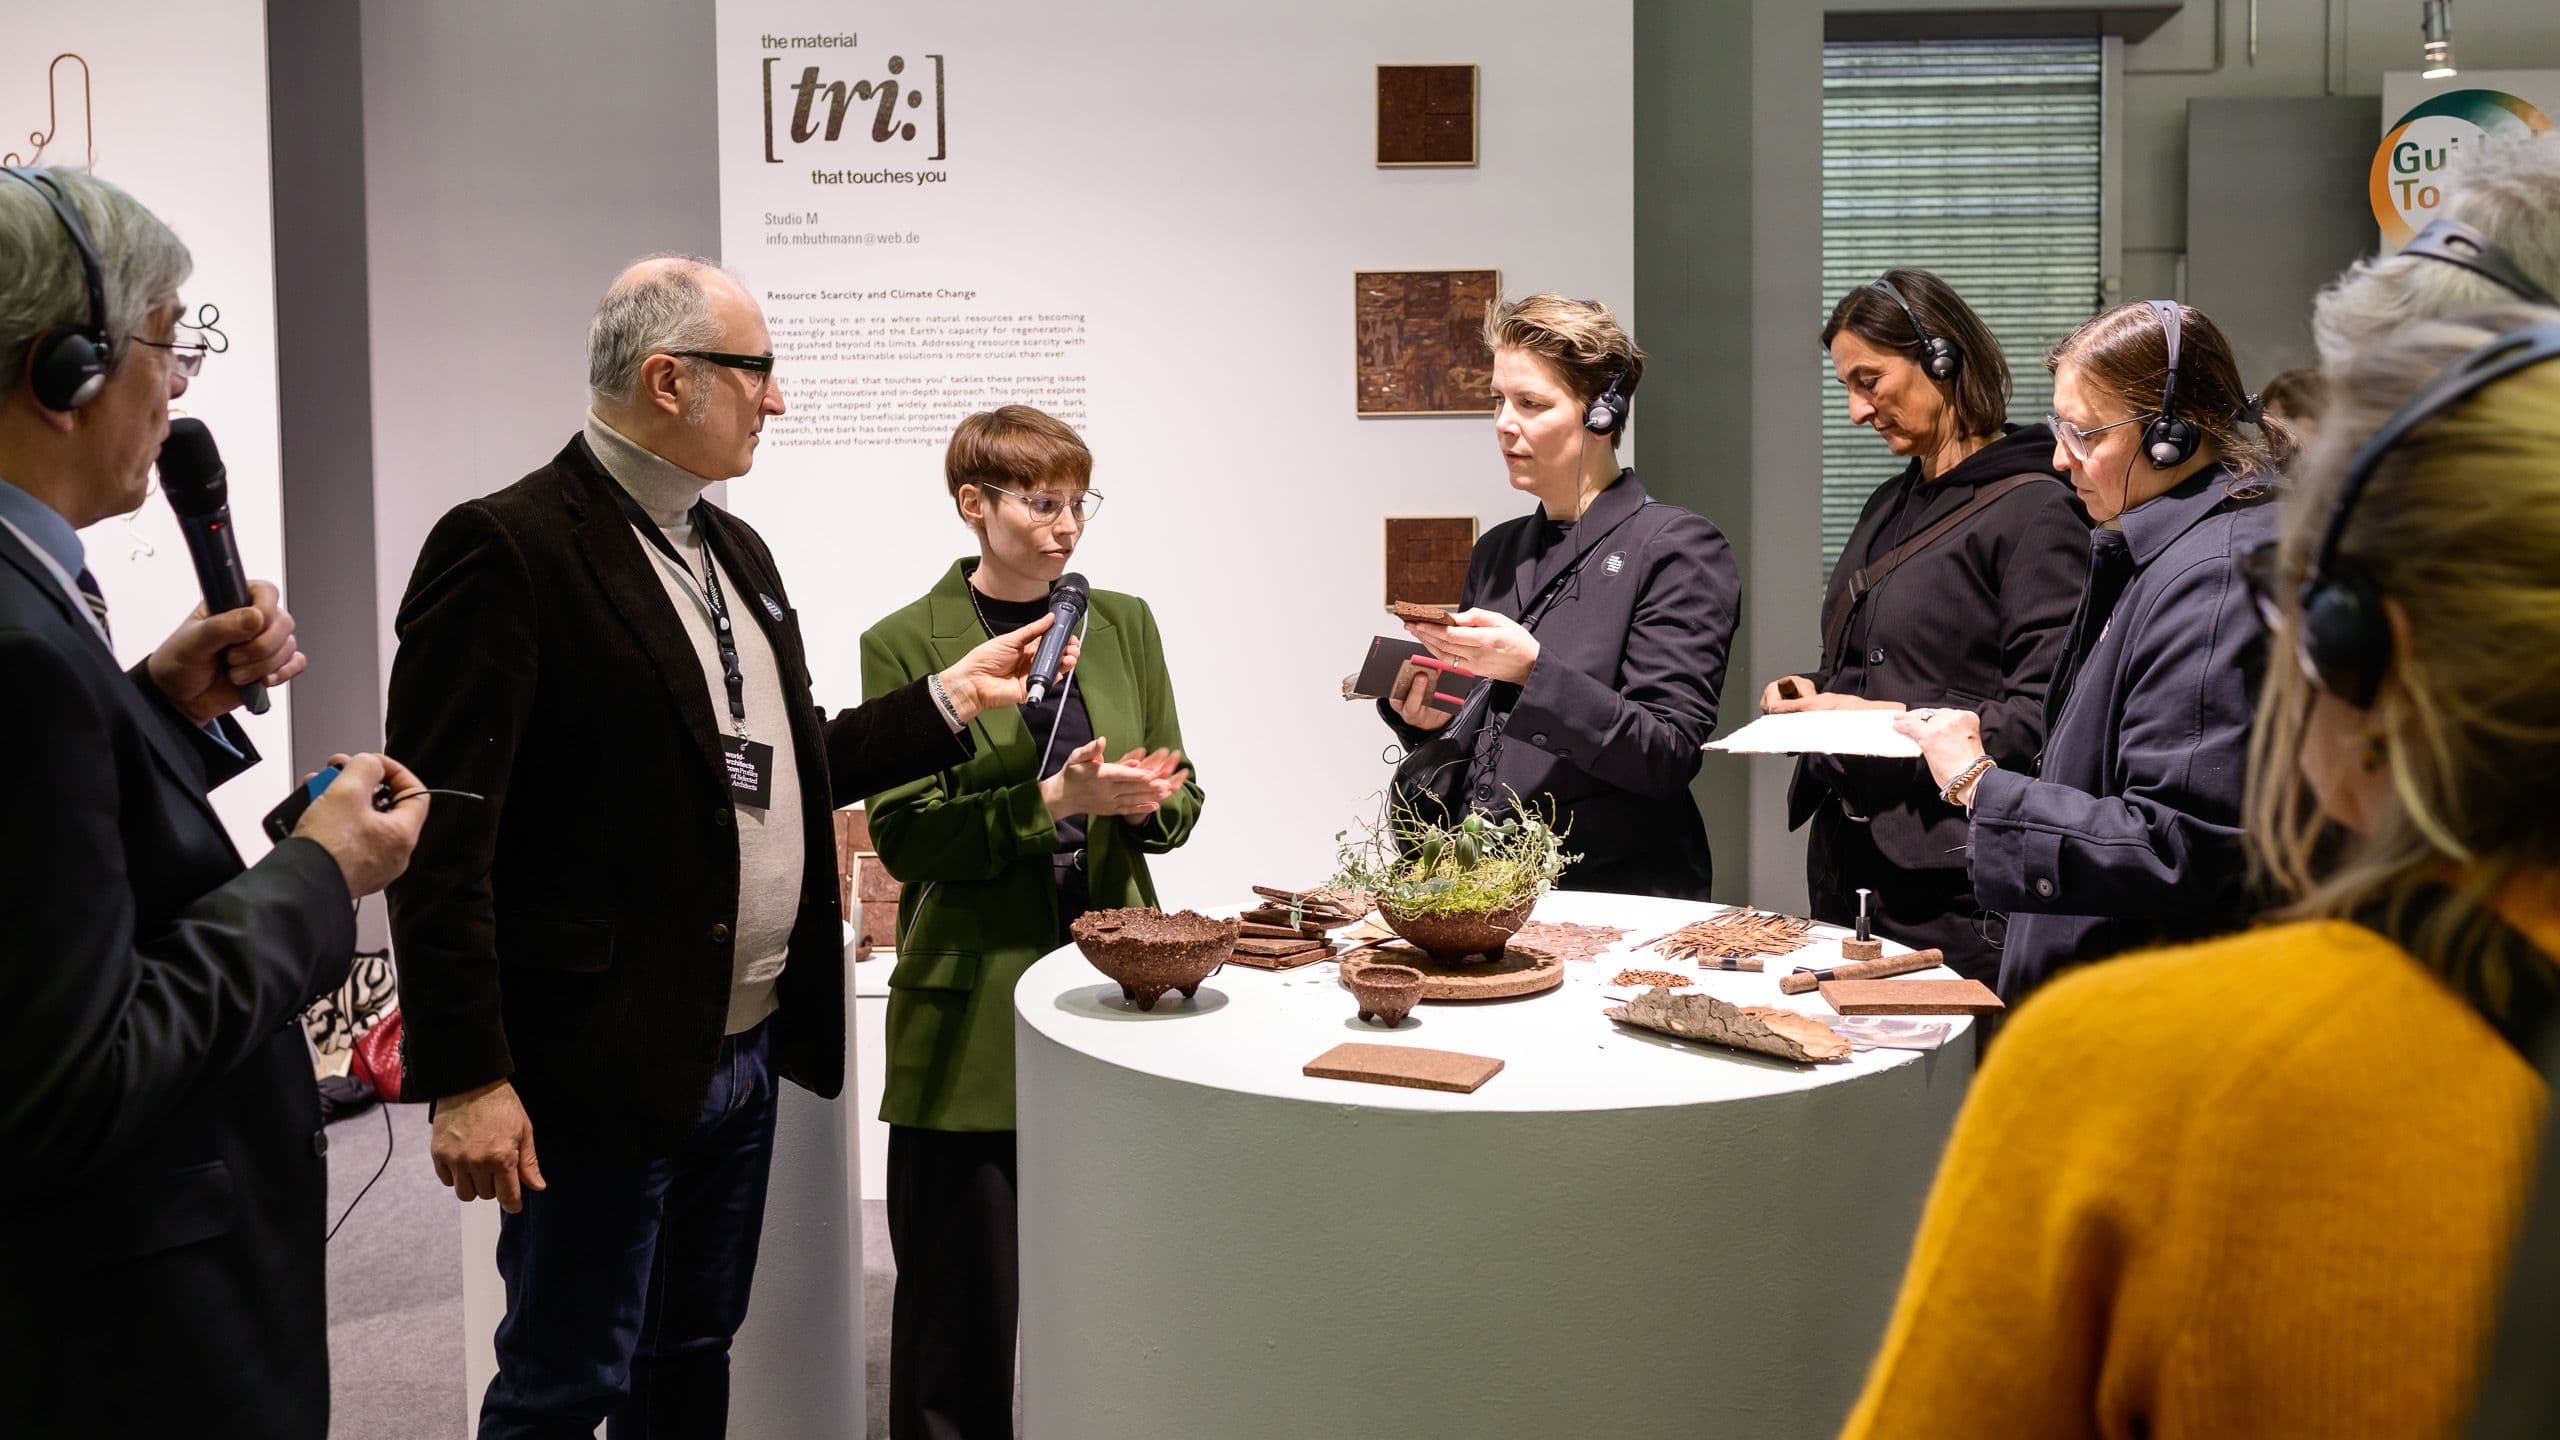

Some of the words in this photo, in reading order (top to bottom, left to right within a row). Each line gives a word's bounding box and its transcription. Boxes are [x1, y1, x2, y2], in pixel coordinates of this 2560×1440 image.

[761, 34, 788, 49] the
[791, 33, 858, 48] material
[812, 169, 844, 185] that
[847, 168, 914, 184] touches
[916, 170, 947, 186] you
[764, 212, 803, 225] Studio
[806, 212, 818, 225] M
[766, 232, 920, 246] info.mbuthmann@web.de
[768, 290, 817, 300] Resource
[821, 289, 863, 302] Scarcity
[867, 289, 886, 299] and
[889, 289, 933, 299] Climate
[936, 289, 976, 301] Change
[768, 315, 784, 324] We
[809, 315, 835, 326] living
[840, 316, 849, 324] in
[891, 314, 920, 324] where
[926, 314, 960, 323] natural
[1038, 313, 1085, 325] becoming
[868, 326, 885, 336] and
[889, 326, 905, 335] the
[948, 327, 988, 337] capacity
[993, 326, 1007, 335] for
[1012, 326, 1073, 337] regeneration
[1077, 326, 1085, 334] is
[775, 340, 794, 350] eing
[797, 339, 832, 350] pushed
[835, 339, 870, 350] beyond
[874, 339, 886, 348] its
[921, 338, 975, 349] Addressing
[1021, 338, 1061, 348] scarcity
[1063, 337, 1085, 346] with
[821, 351, 838, 360] and
[841, 350, 895, 360] sustainable
[898, 350, 943, 359] solutions
[946, 351, 953, 359] is
[984, 349, 1016, 359] crucial
[1020, 349, 1041, 358] than
[801, 375, 816, 384] the
[820, 375, 858, 384] material
[862, 375, 881, 384] that
[883, 374, 922, 383] touches
[950, 374, 984, 383] tackles
[987, 374, 1012, 383] these
[1016, 374, 1055, 385] pressing
[1058, 374, 1087, 382] issues
[800, 387, 828, 399] highly
[831, 388, 878, 396] innovative
[880, 387, 897, 396] and
[899, 386, 940, 398] in-depth
[990, 386, 1008, 395] This
[1011, 385, 1044, 397] project
[1046, 385, 1086, 396] explores
[791, 399, 822, 411] largely
[826, 399, 871, 410] untapped
[876, 400, 891, 410] yet
[897, 398, 927, 410] widely
[932, 398, 972, 407] available
[1039, 398, 1058, 406] tree
[769, 412, 816, 423] leveraging
[819, 412, 830, 420] its
[833, 414, 858, 422] many
[860, 411, 906, 420] beneficial
[815, 425, 834, 433] tree
[837, 423, 856, 433] bark
[859, 423, 875, 432] has
[877, 423, 900, 432] been
[902, 423, 950, 432] combined
[779, 436, 831, 446] sustainable
[834, 436, 851, 445] and
[854, 435, 932, 447] forward-thinking
